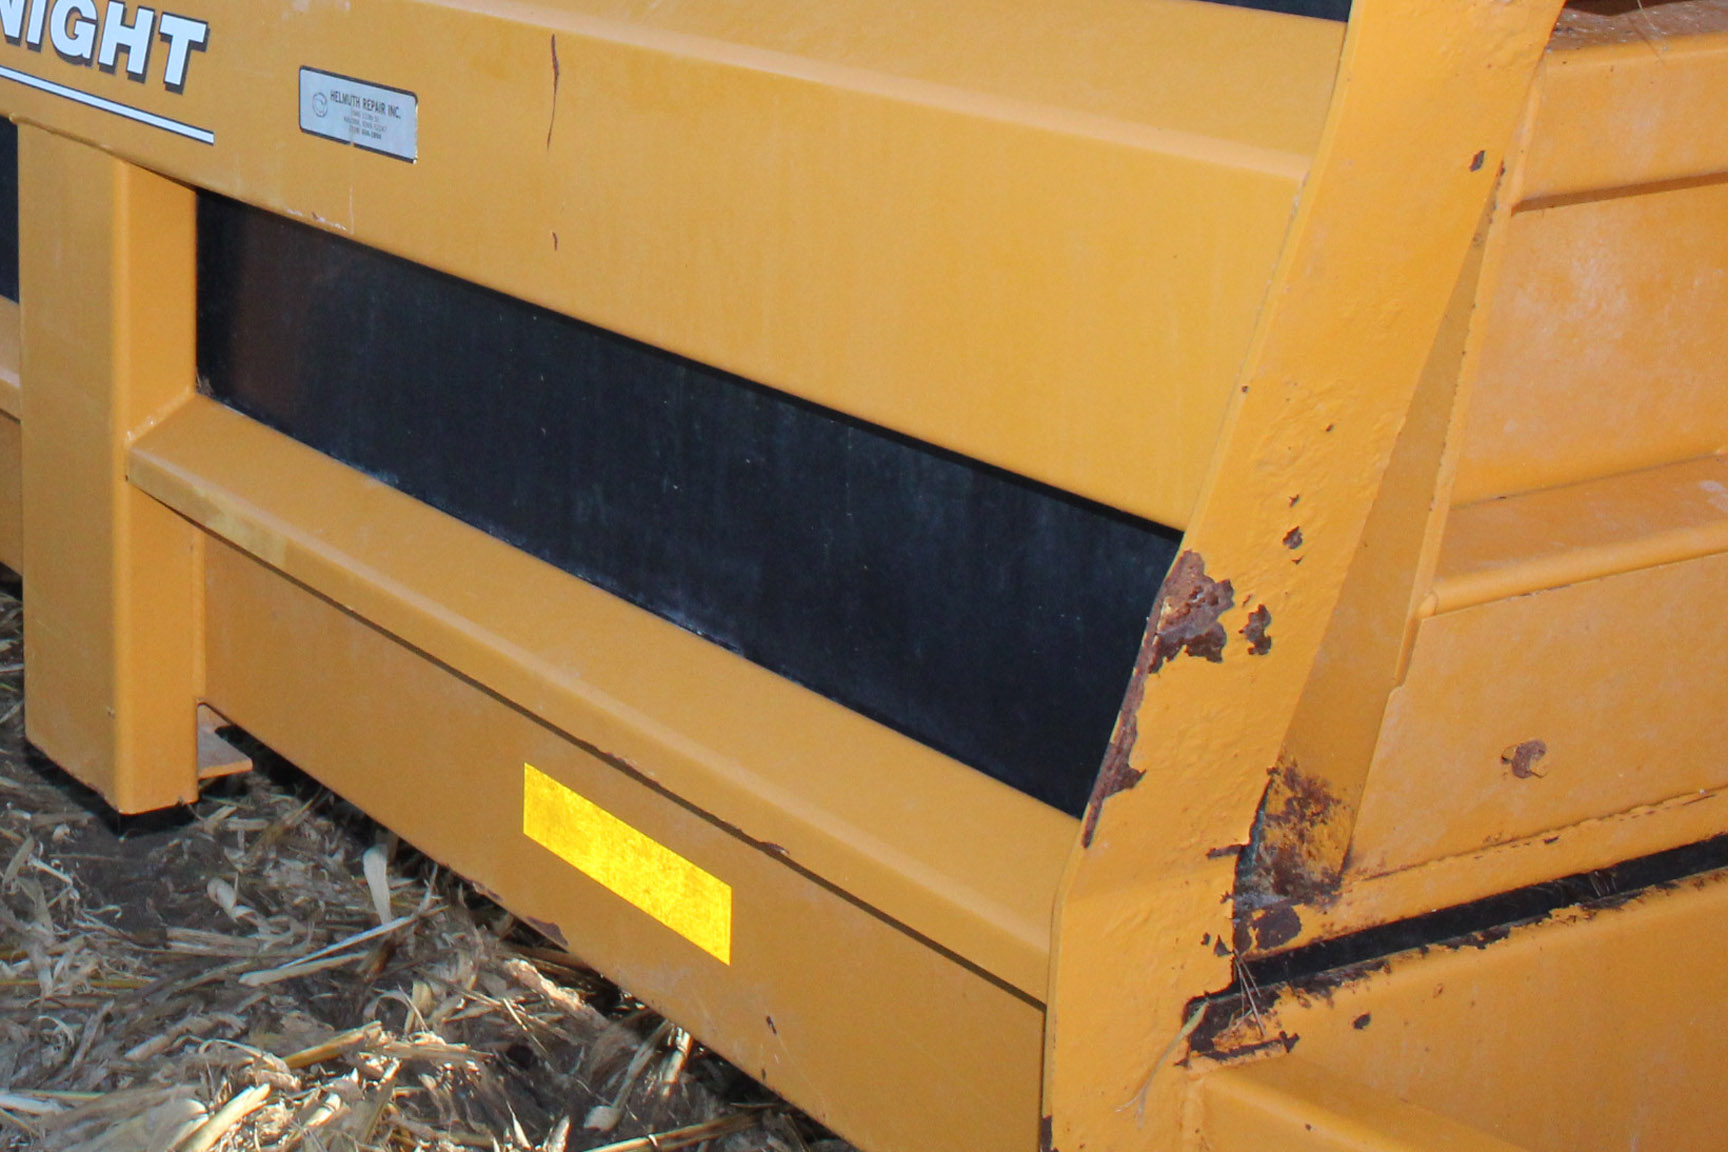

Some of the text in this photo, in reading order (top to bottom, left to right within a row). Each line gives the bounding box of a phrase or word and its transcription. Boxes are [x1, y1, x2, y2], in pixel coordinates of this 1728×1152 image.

[329, 89, 361, 109] HELMUTH
[362, 97, 386, 116] REPAIR
[387, 103, 401, 119] INC.
